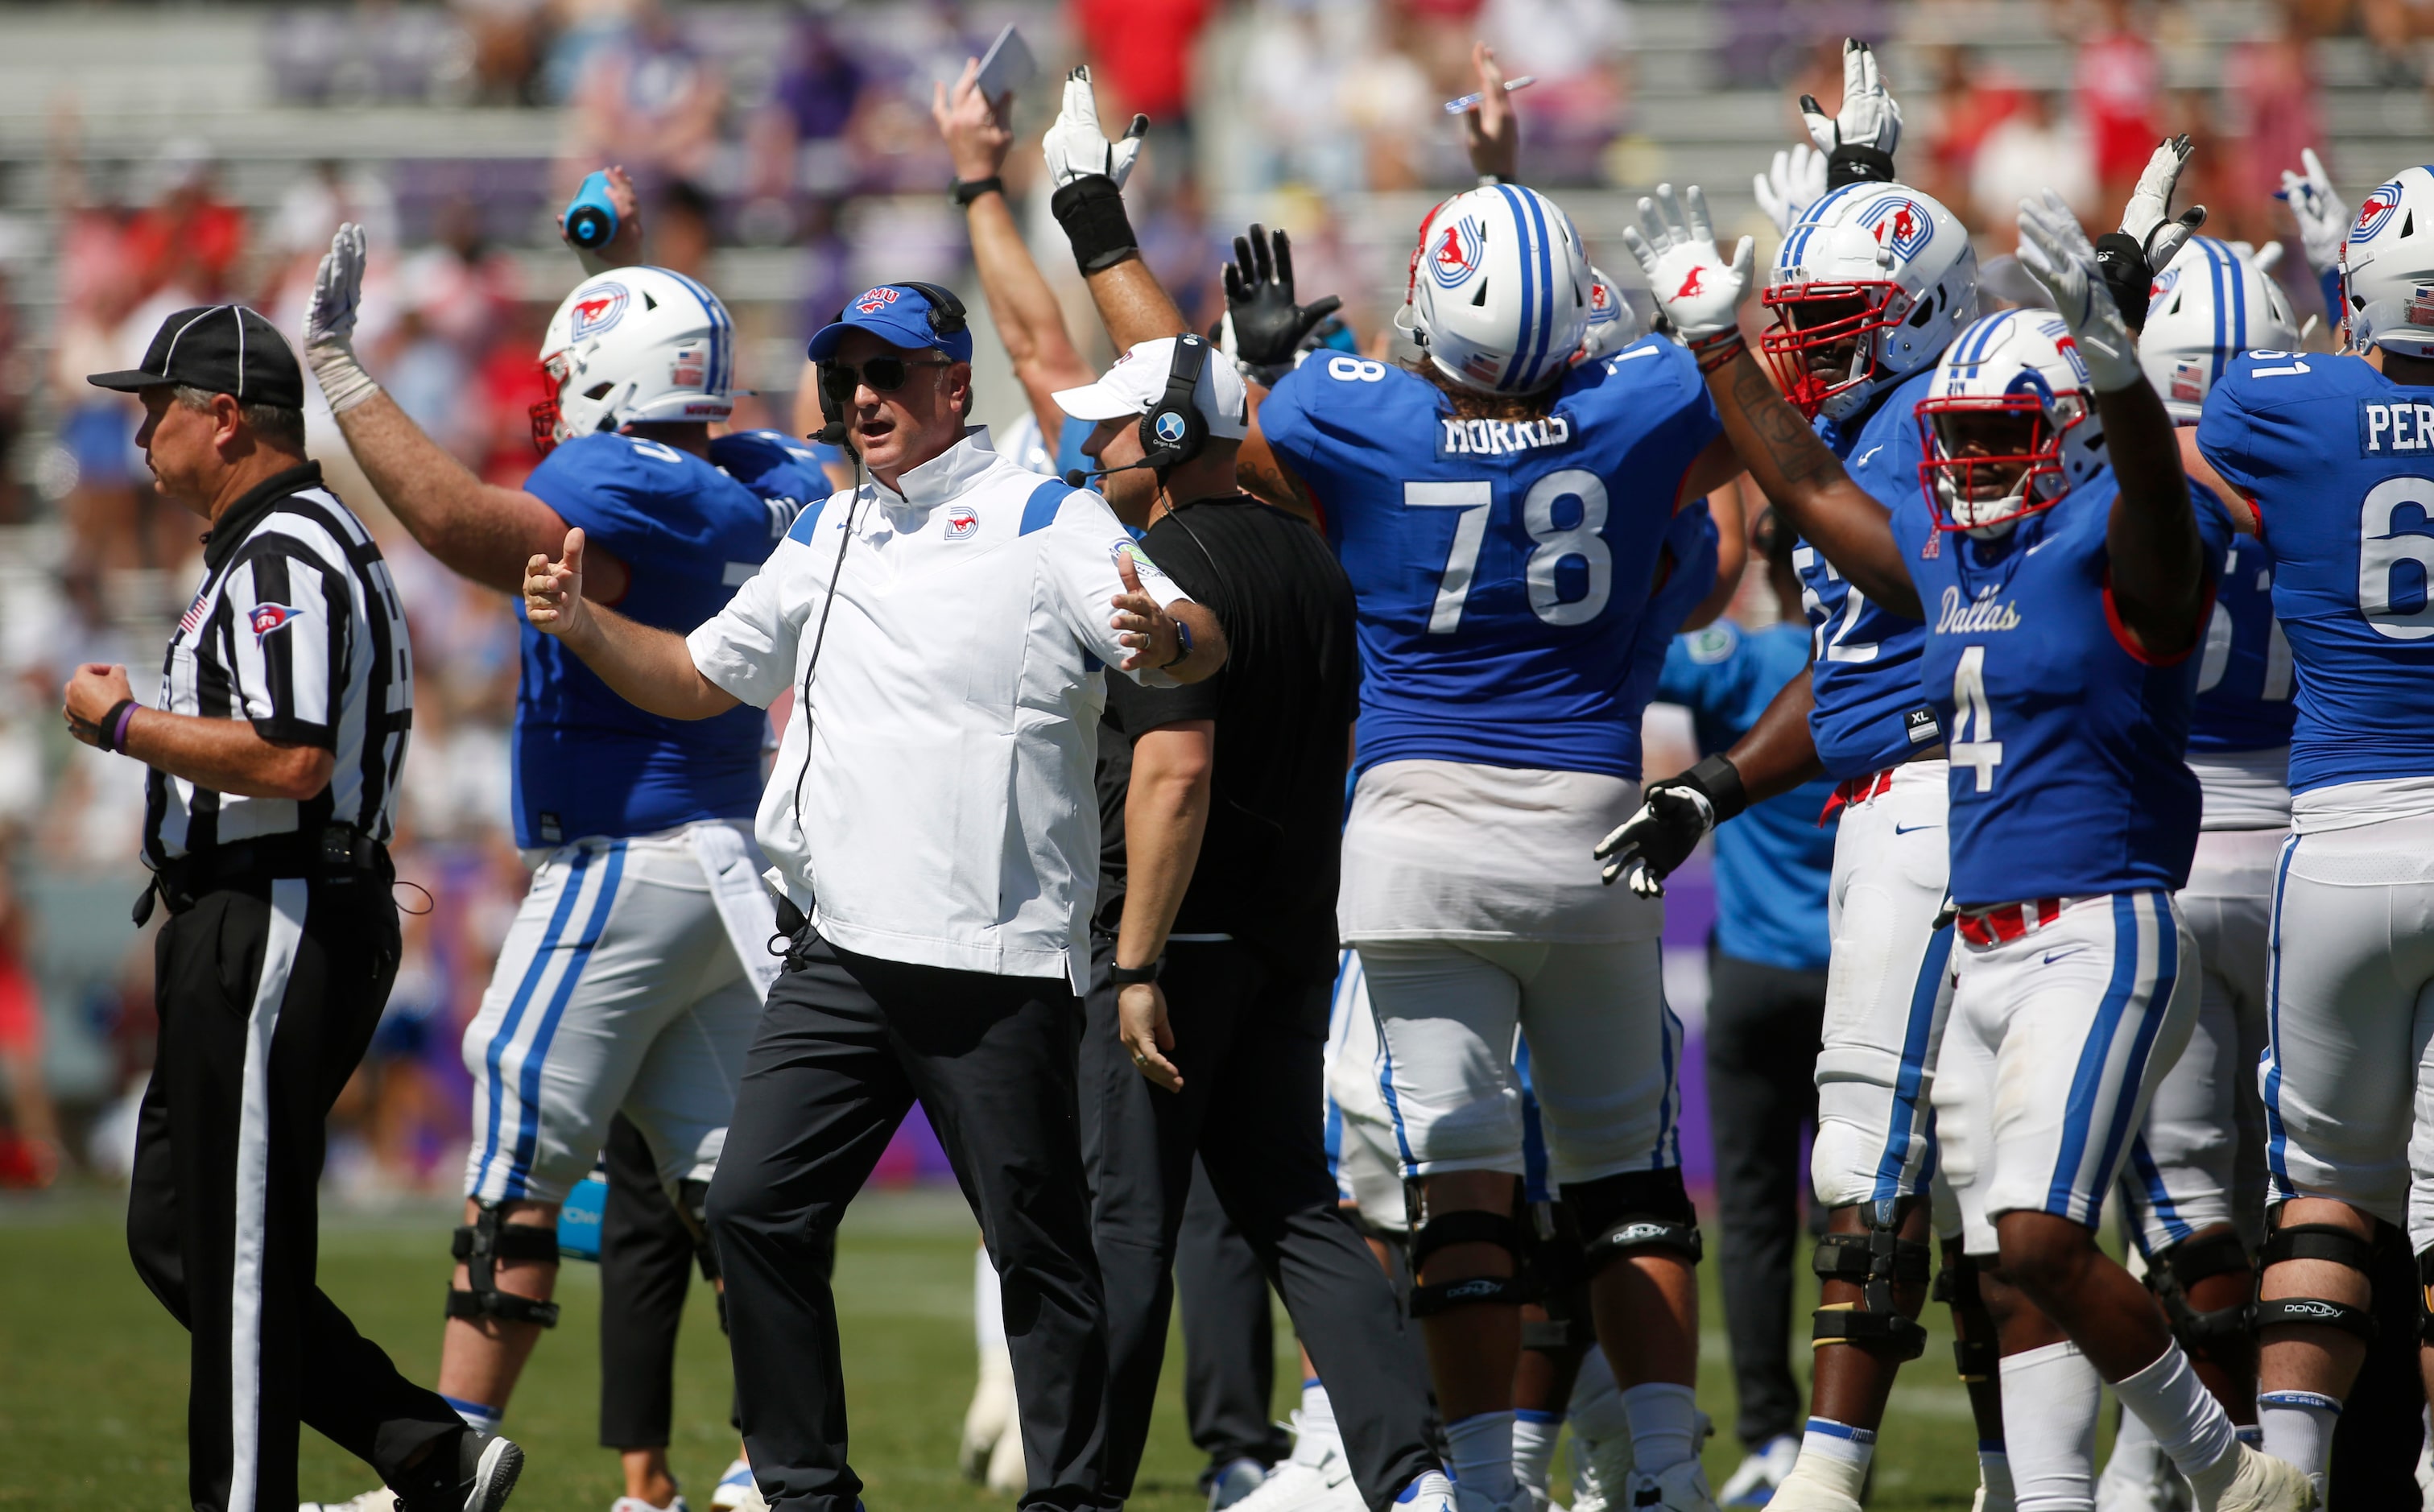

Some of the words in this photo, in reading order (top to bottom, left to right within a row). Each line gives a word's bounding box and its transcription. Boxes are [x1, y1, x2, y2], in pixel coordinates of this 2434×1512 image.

[1153, 439, 1168, 448] Origin
[1168, 442, 1181, 450] Bank
[1440, 416, 1570, 456] MORRIS
[1403, 468, 1612, 634] 78
[1935, 584, 2021, 634] Dallas
[1911, 711, 1929, 724] XL
[1949, 646, 2003, 792] 4
[2284, 1301, 2344, 1318] DONJOY
